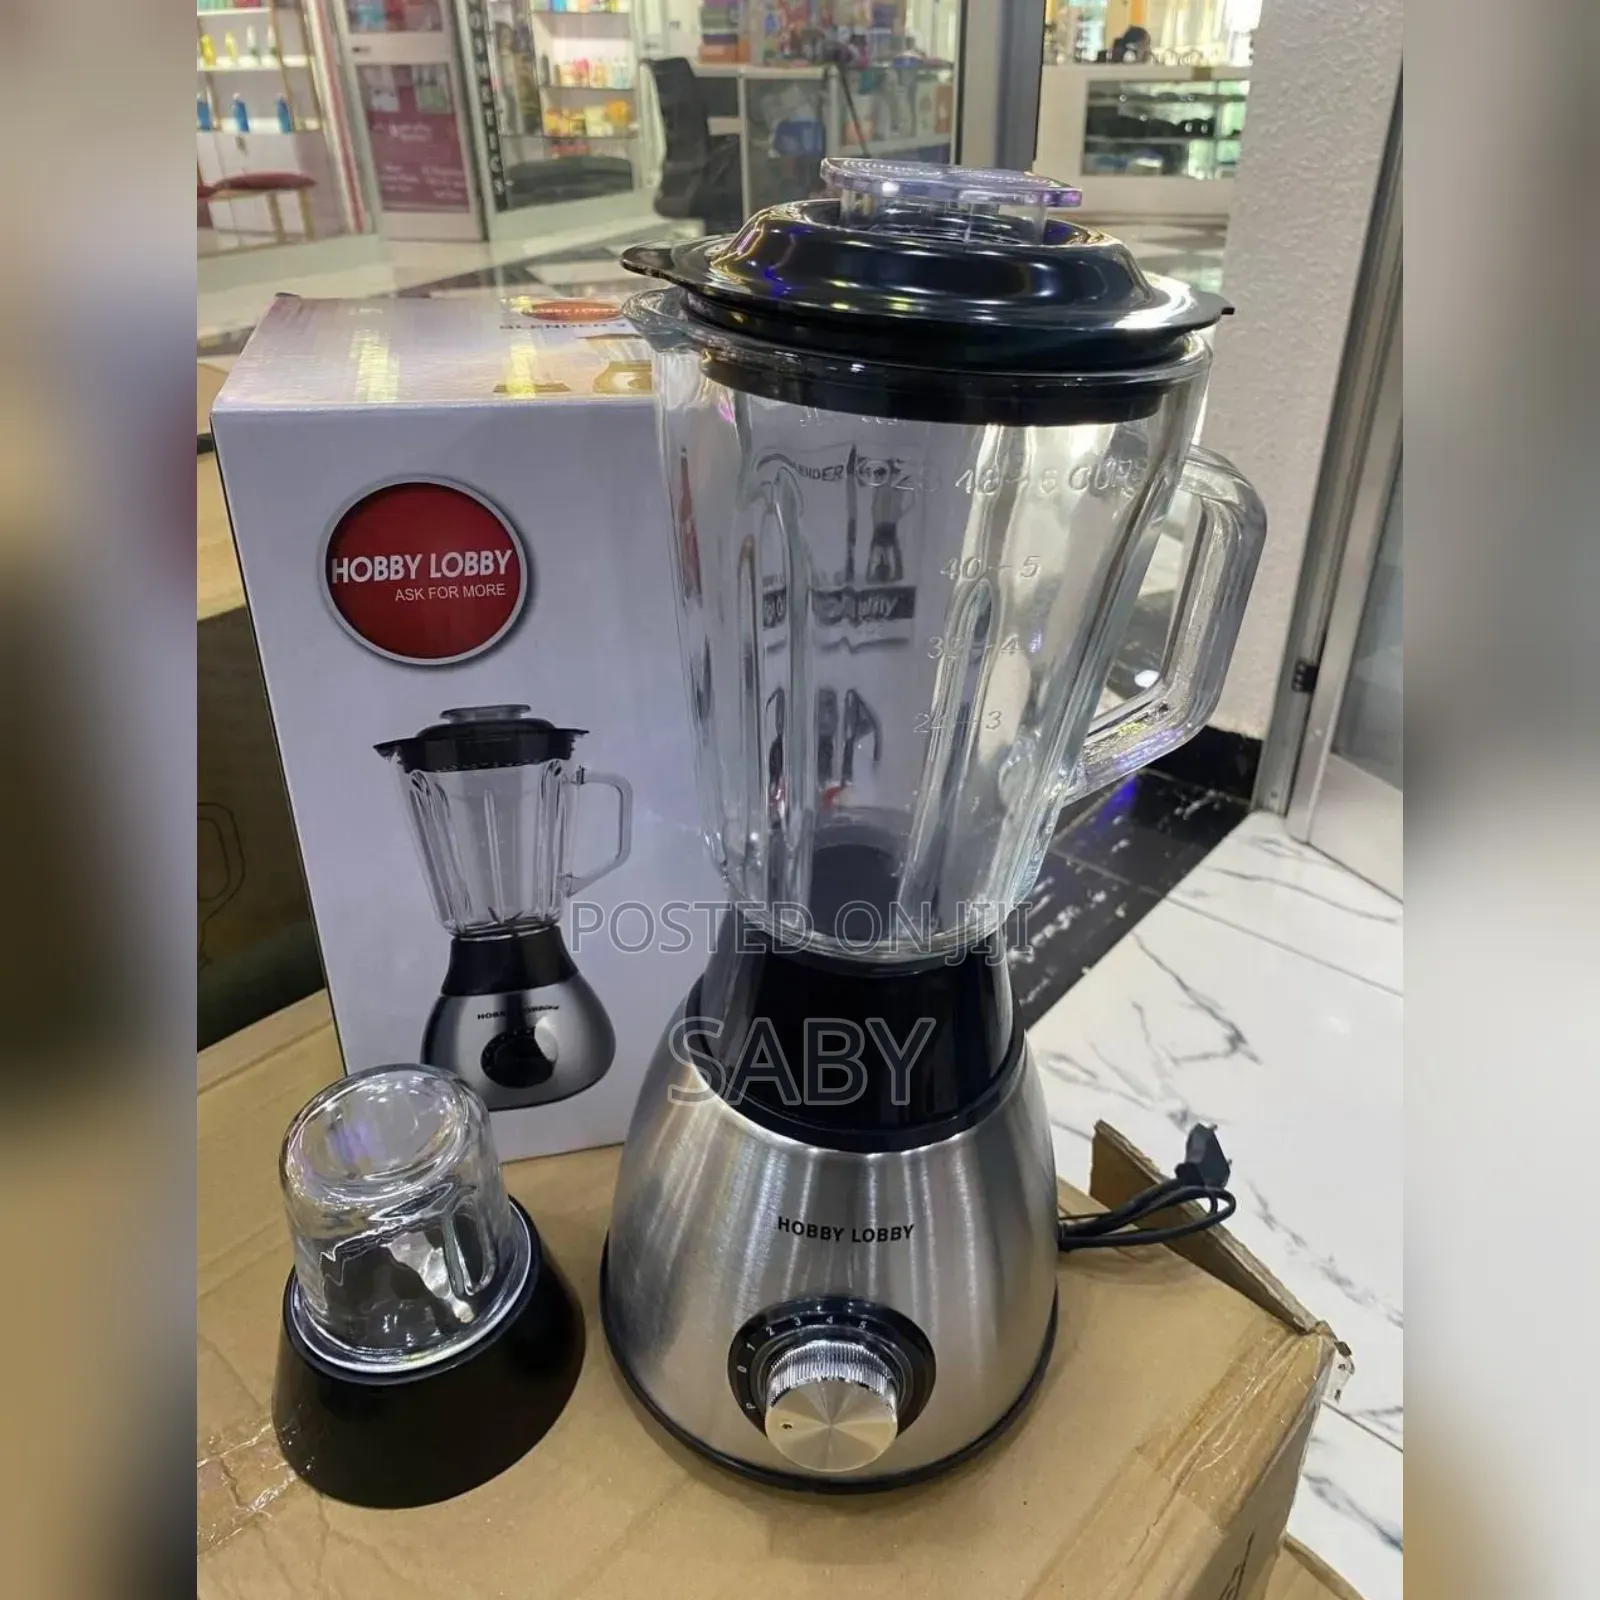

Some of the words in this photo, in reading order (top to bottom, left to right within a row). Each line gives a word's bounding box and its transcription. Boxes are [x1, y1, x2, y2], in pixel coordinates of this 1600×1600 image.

[332, 554, 422, 584] HOBBY
[429, 549, 513, 579] LOBBY
[1020, 555, 1041, 578] 5
[395, 588, 425, 602] ASK
[428, 586, 460, 600] FOR
[463, 583, 507, 598] MORE
[778, 1216, 845, 1242] HOBBY
[852, 1225, 915, 1243] LOBBY
